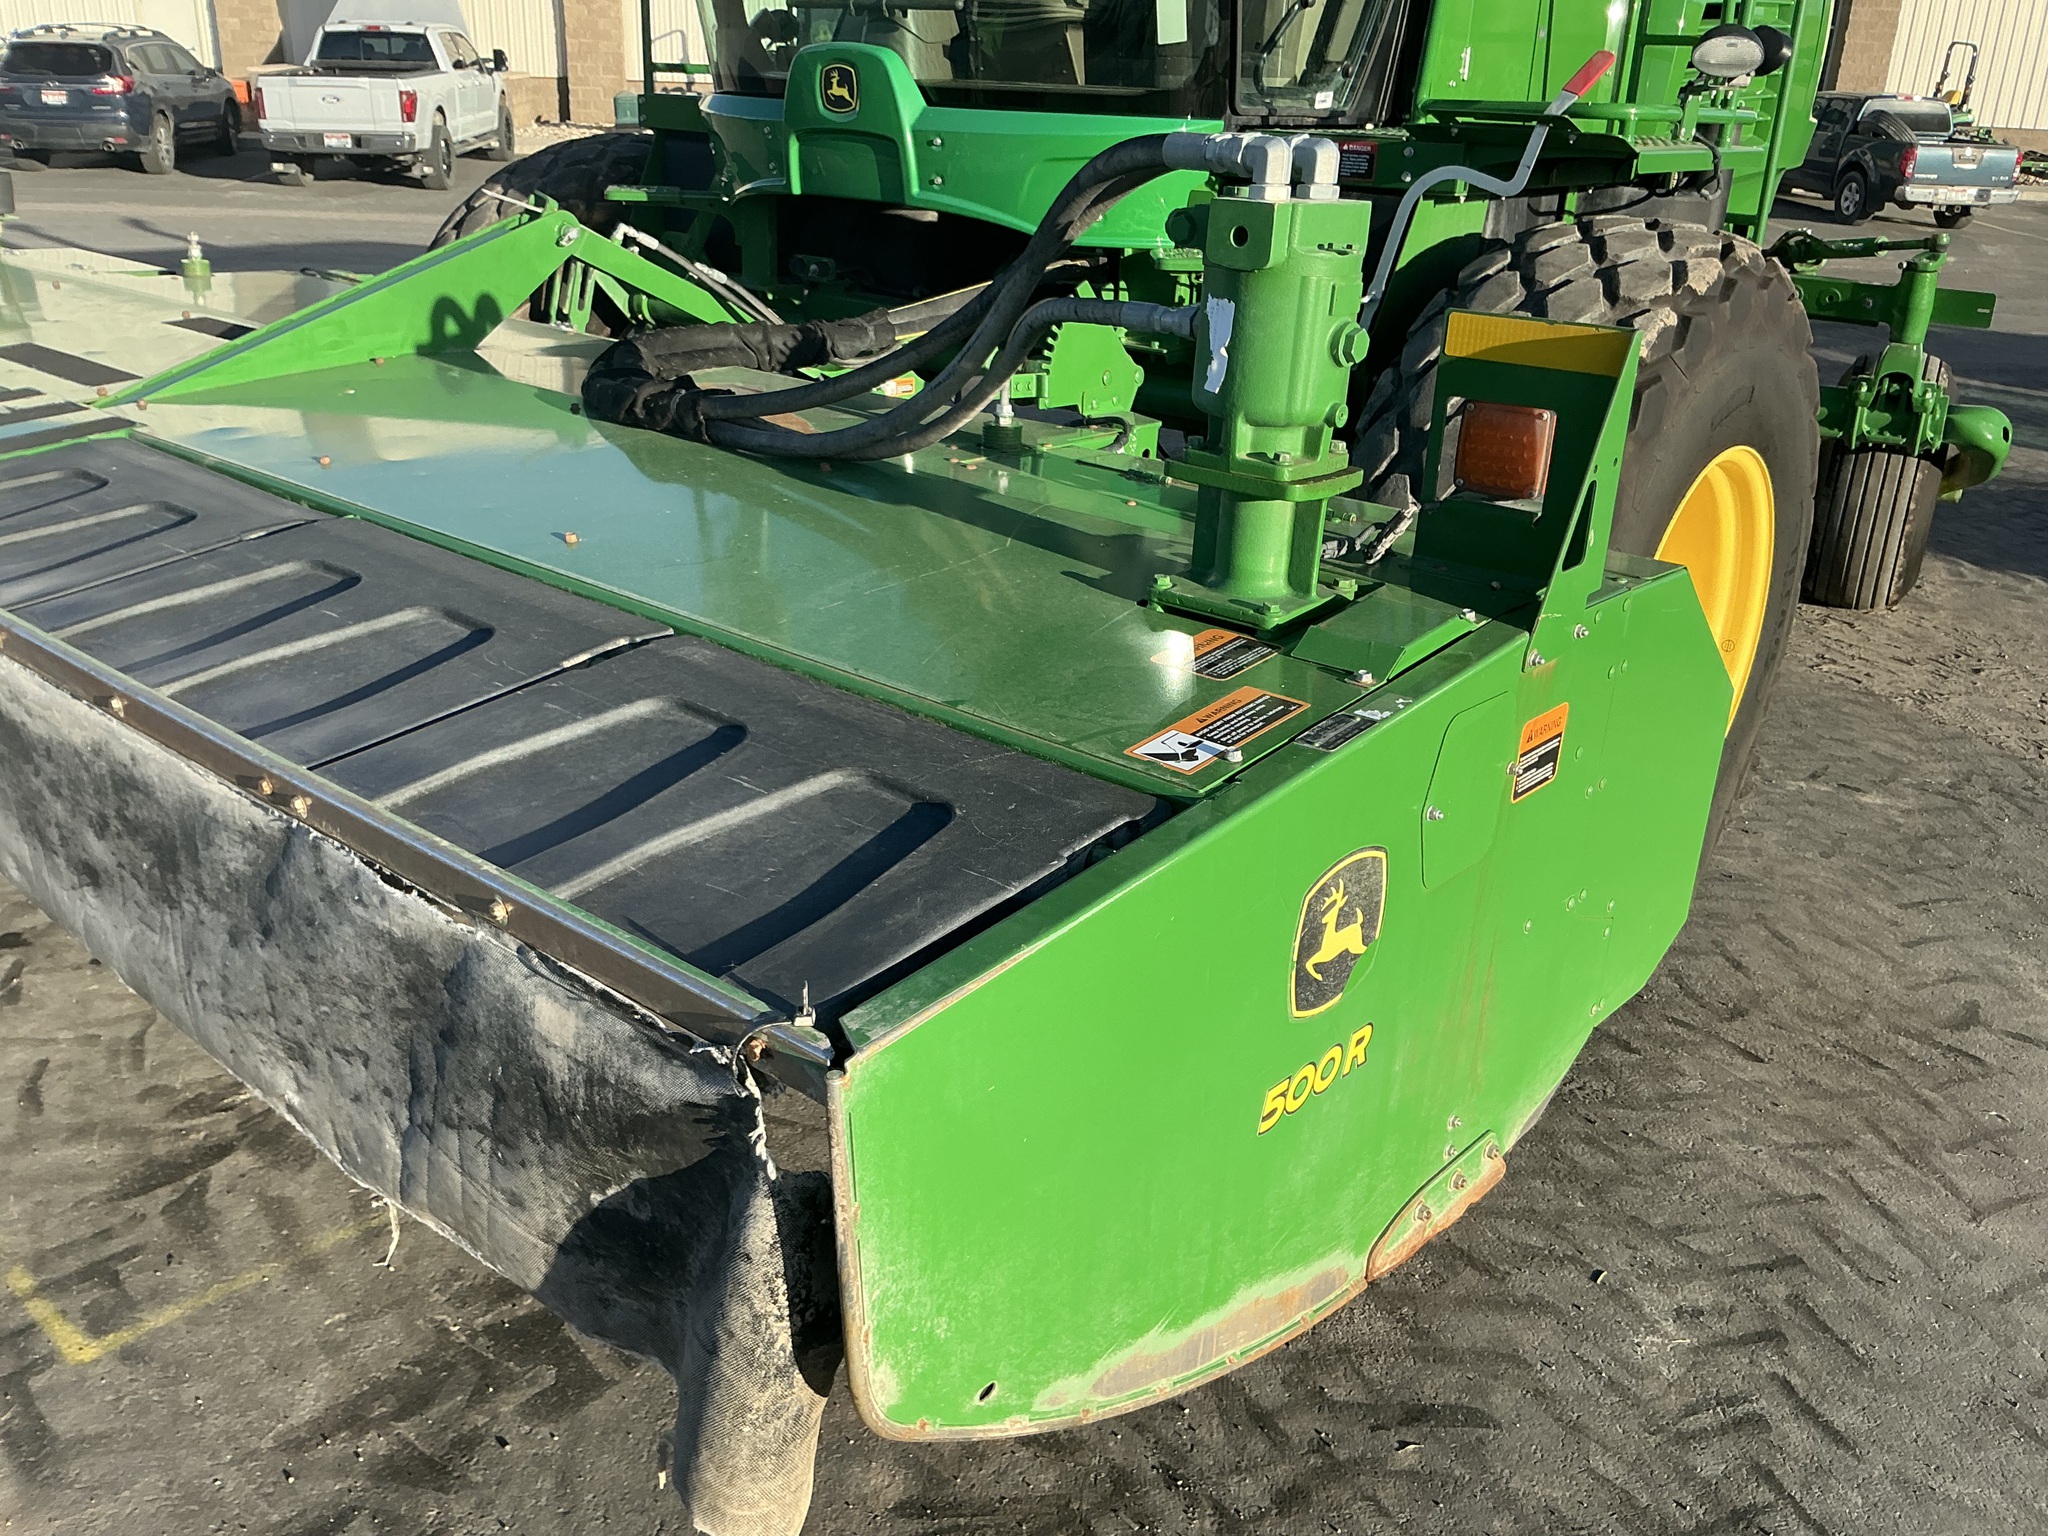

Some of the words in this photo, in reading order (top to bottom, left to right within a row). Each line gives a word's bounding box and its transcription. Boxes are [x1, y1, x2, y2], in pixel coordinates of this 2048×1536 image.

[1349, 144, 1371, 152] DANGER
[1202, 698, 1242, 719] WARNING
[1533, 716, 1562, 740] WARNING
[1256, 1021, 1375, 1137] 500R
